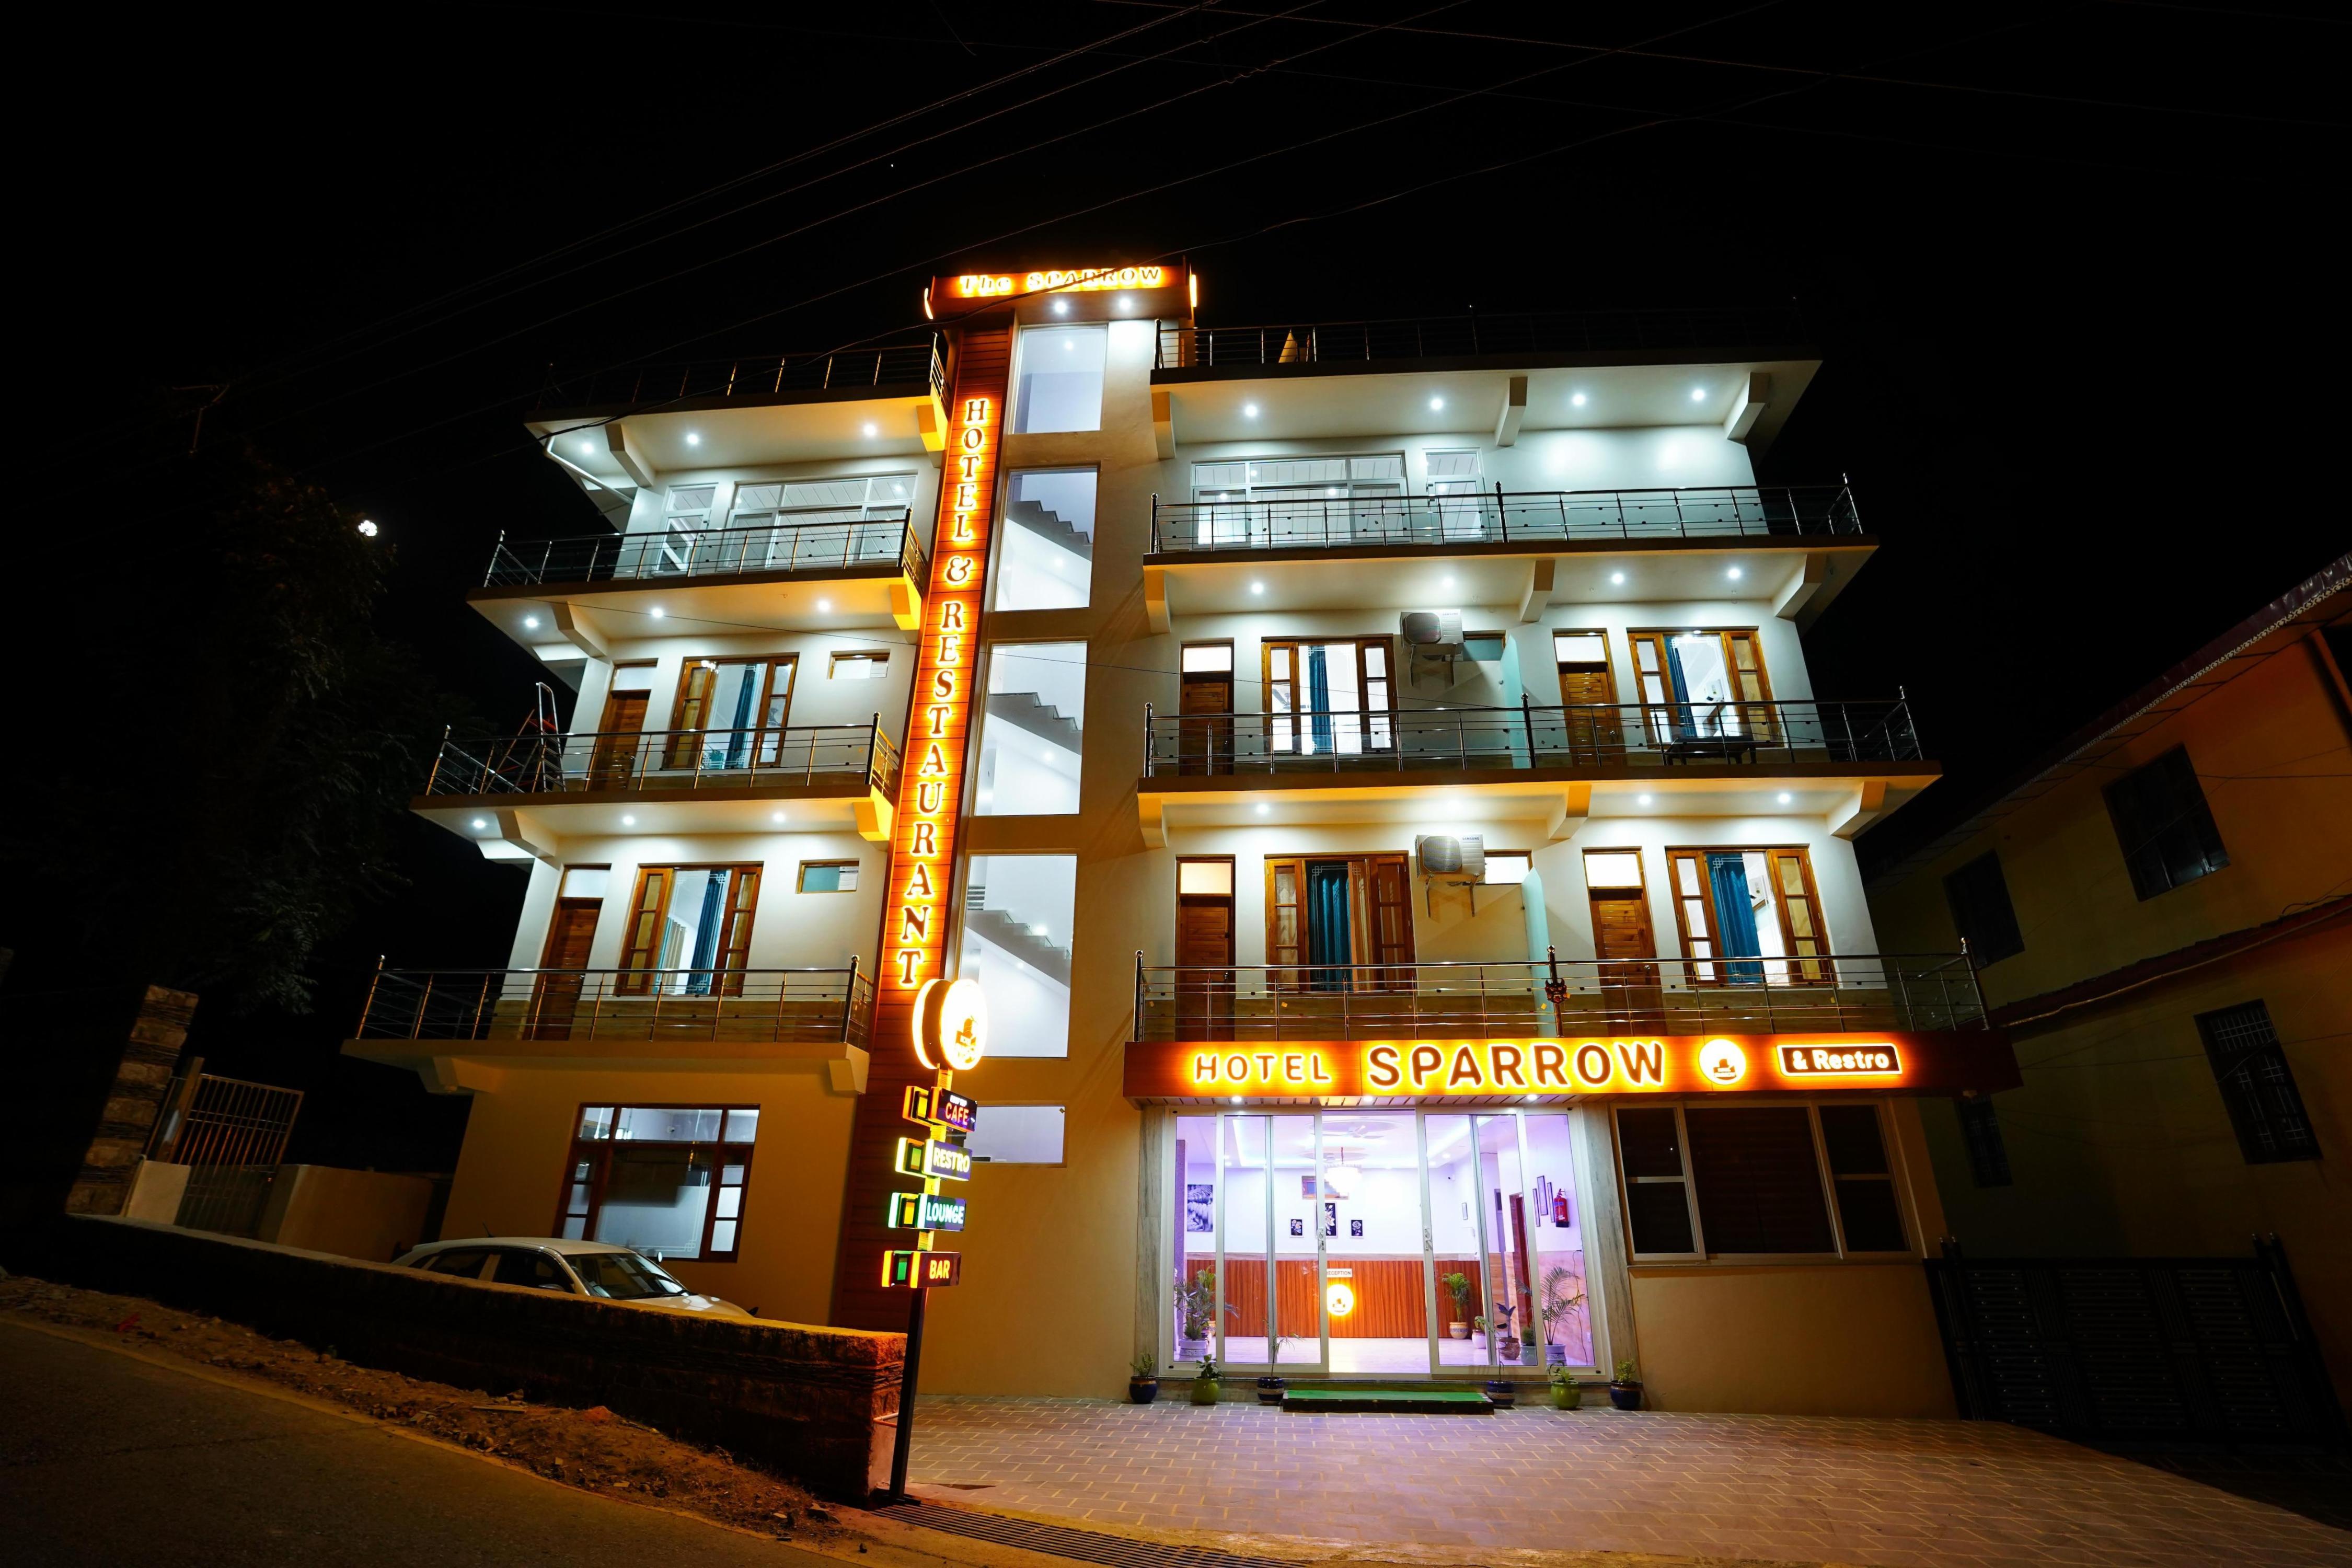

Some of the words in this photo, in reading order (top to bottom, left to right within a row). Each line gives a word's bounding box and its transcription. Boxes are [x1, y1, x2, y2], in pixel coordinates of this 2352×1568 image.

[961, 276, 1010, 293] The
[1028, 267, 1160, 288] SPARROW
[954, 400, 986, 538] HOTEL
[946, 558, 971, 582] &
[898, 603, 962, 984] RESTAURANT
[1196, 1054, 1329, 1081] HOTEL
[1369, 1043, 1662, 1086] SPARROW
[1792, 1051, 1808, 1069] &
[1812, 1050, 1889, 1069] Restro
[946, 1102, 969, 1126] CAFE
[933, 1147, 970, 1172] RESTRO
[926, 1202, 964, 1224] LOUNGE
[929, 1260, 950, 1279] BAR
